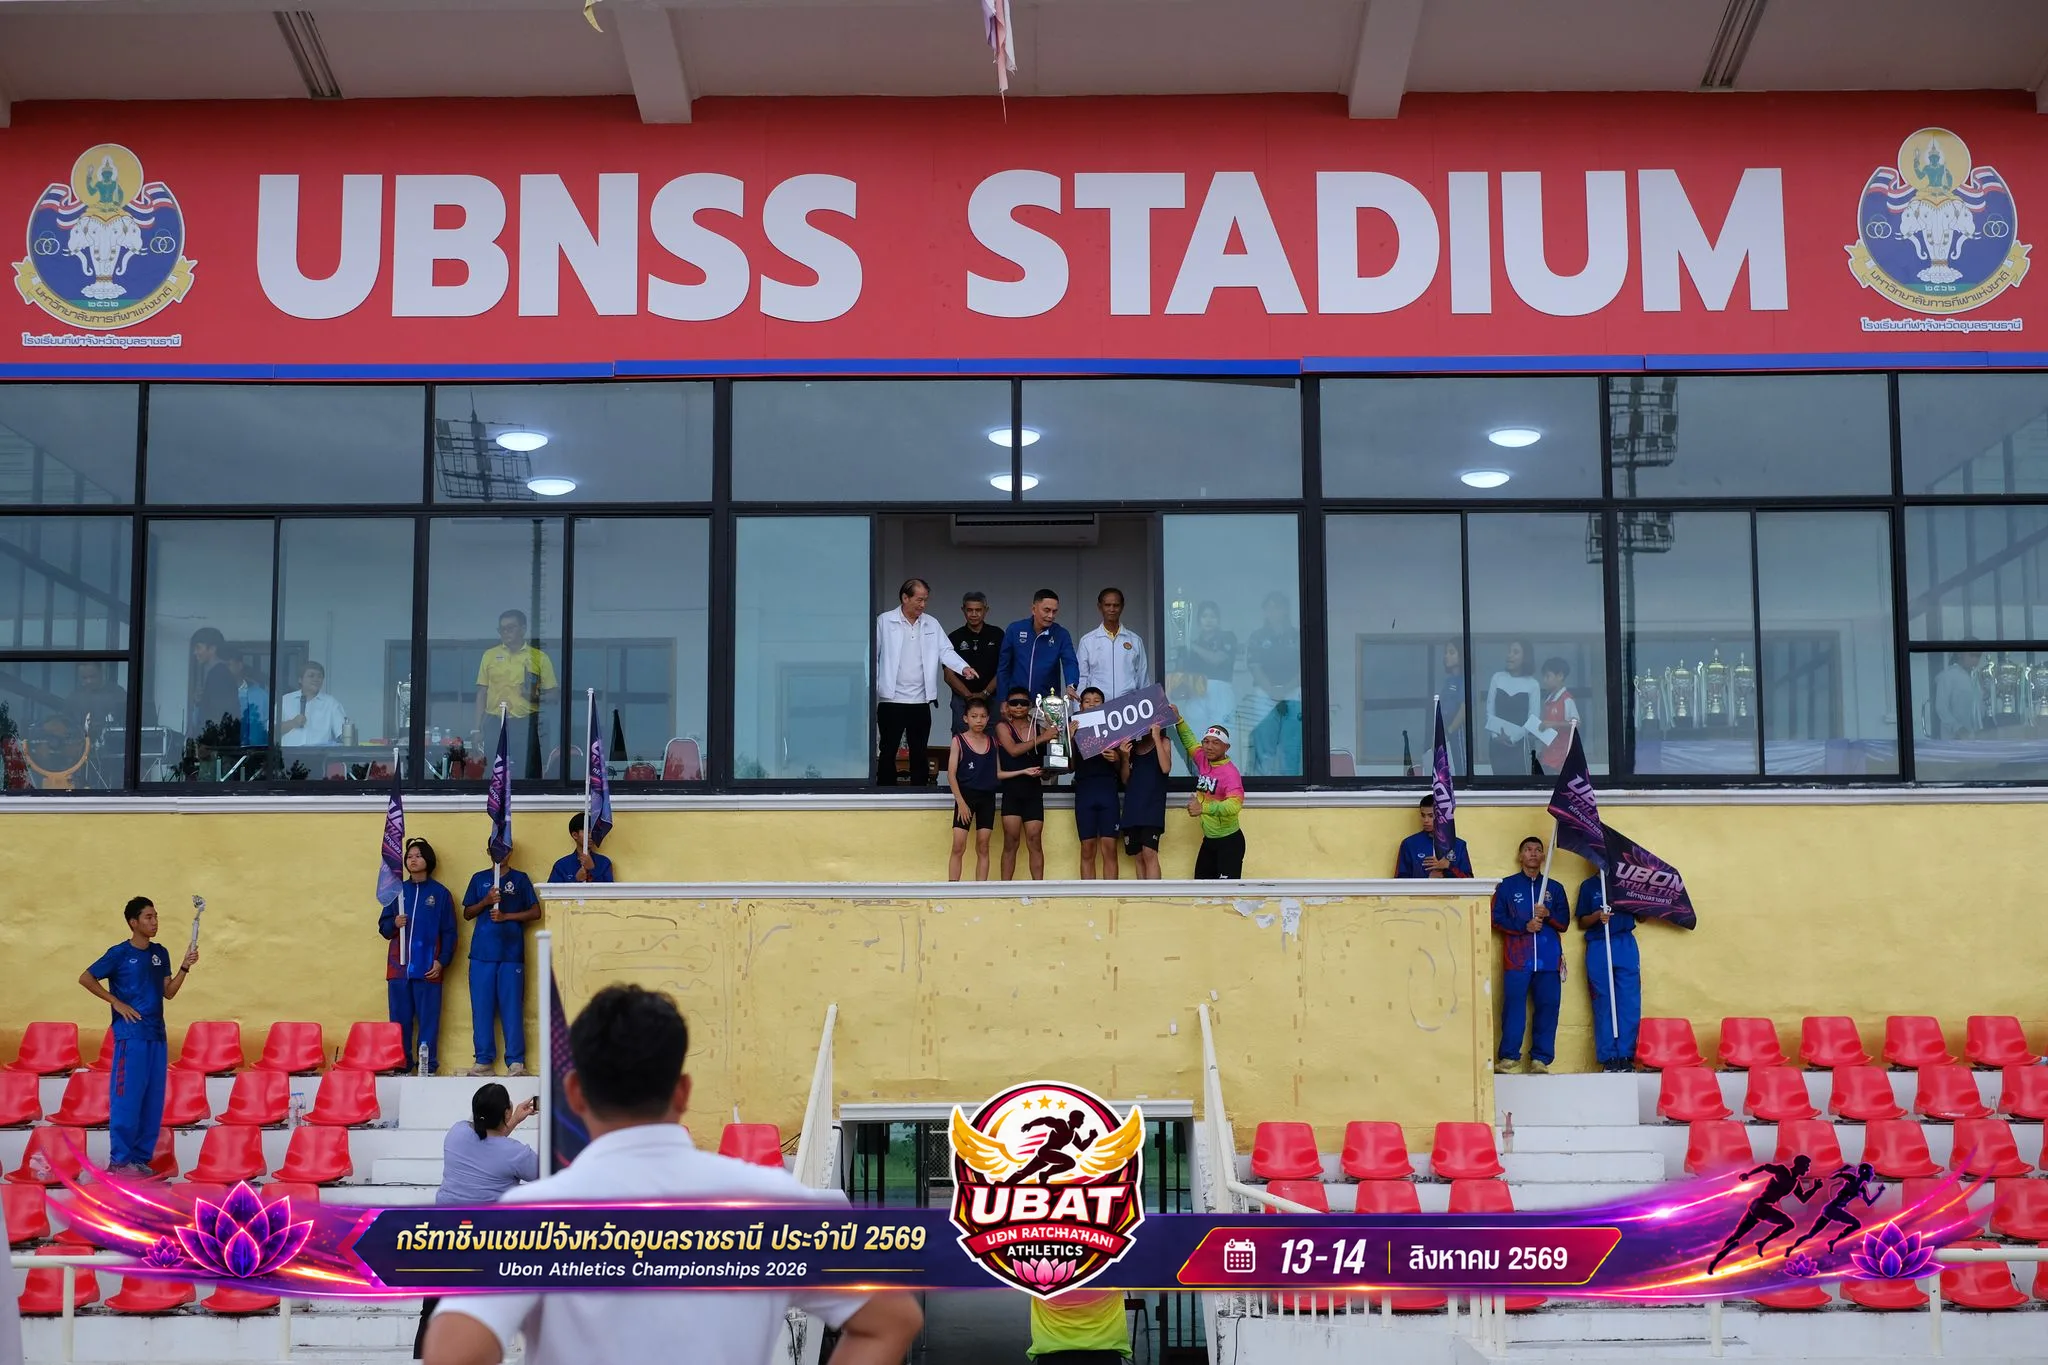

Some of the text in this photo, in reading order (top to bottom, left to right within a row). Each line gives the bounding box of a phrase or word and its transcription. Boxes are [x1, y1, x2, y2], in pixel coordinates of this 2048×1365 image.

[256, 168, 1789, 322] UBNSS STADIUM
[1616, 862, 1684, 892] UBON
